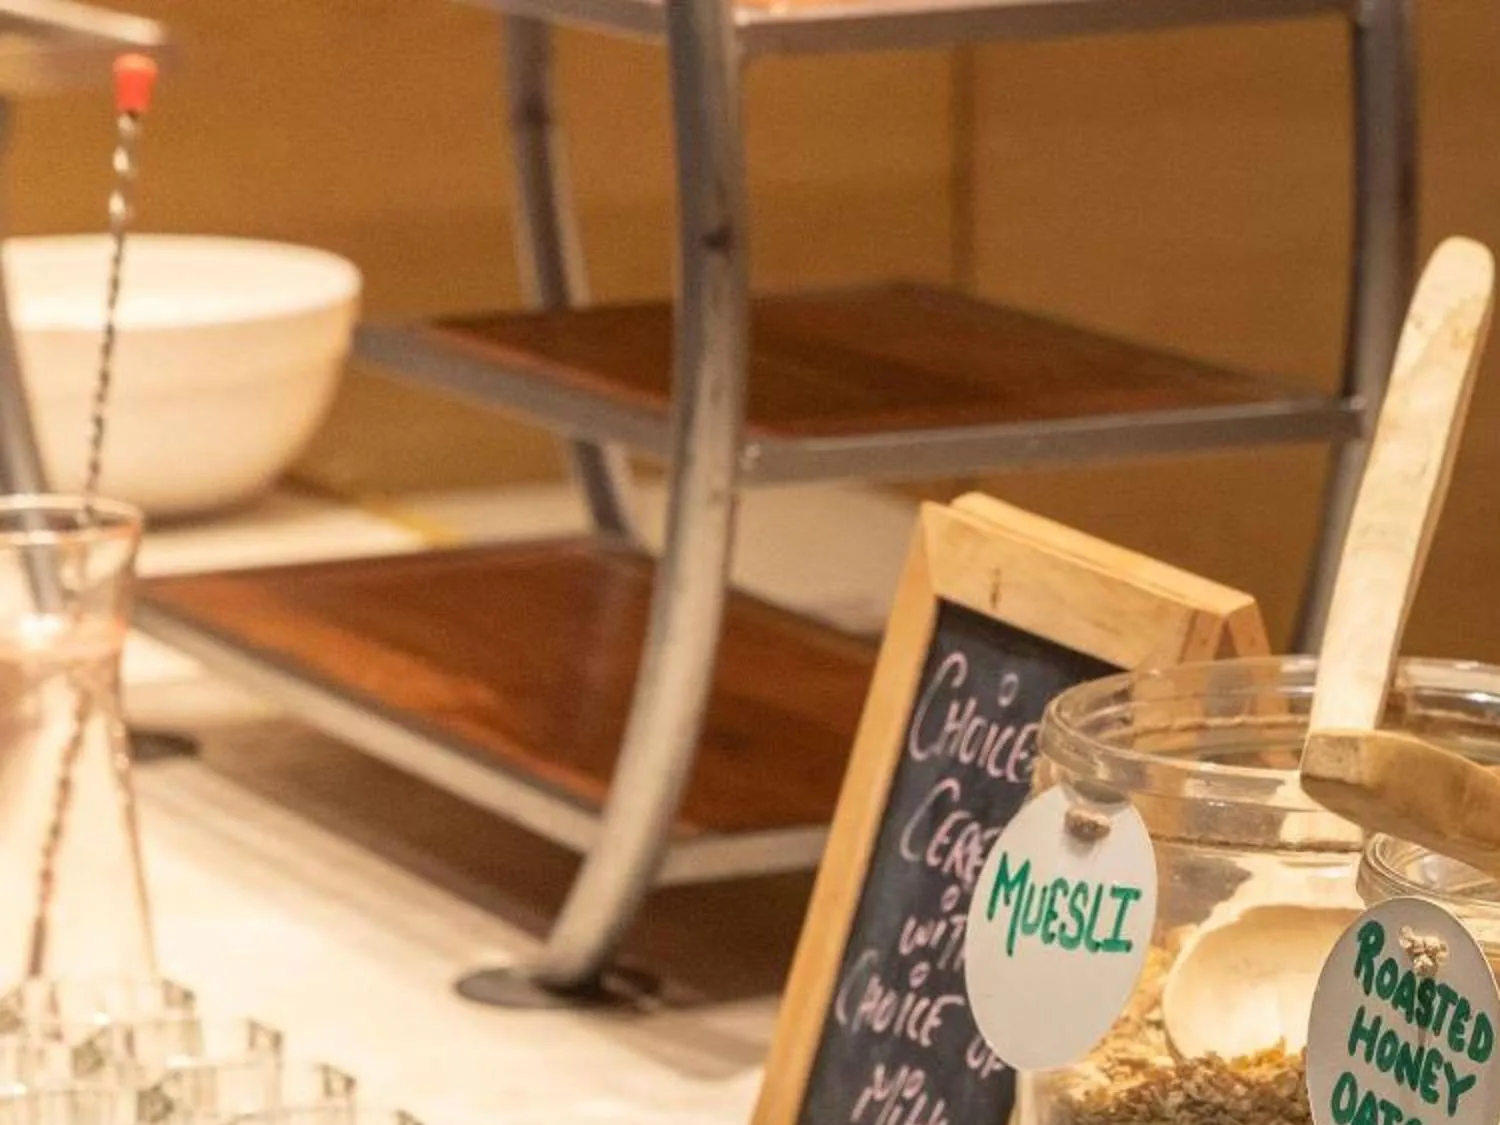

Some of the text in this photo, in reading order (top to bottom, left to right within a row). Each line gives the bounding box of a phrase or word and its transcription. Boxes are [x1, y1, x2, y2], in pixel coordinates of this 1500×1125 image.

[899, 885, 969, 972] WIT
[986, 851, 1143, 957] MUESLI
[1353, 920, 1495, 1063] ROASTED
[1348, 1004, 1477, 1118] HONEY
